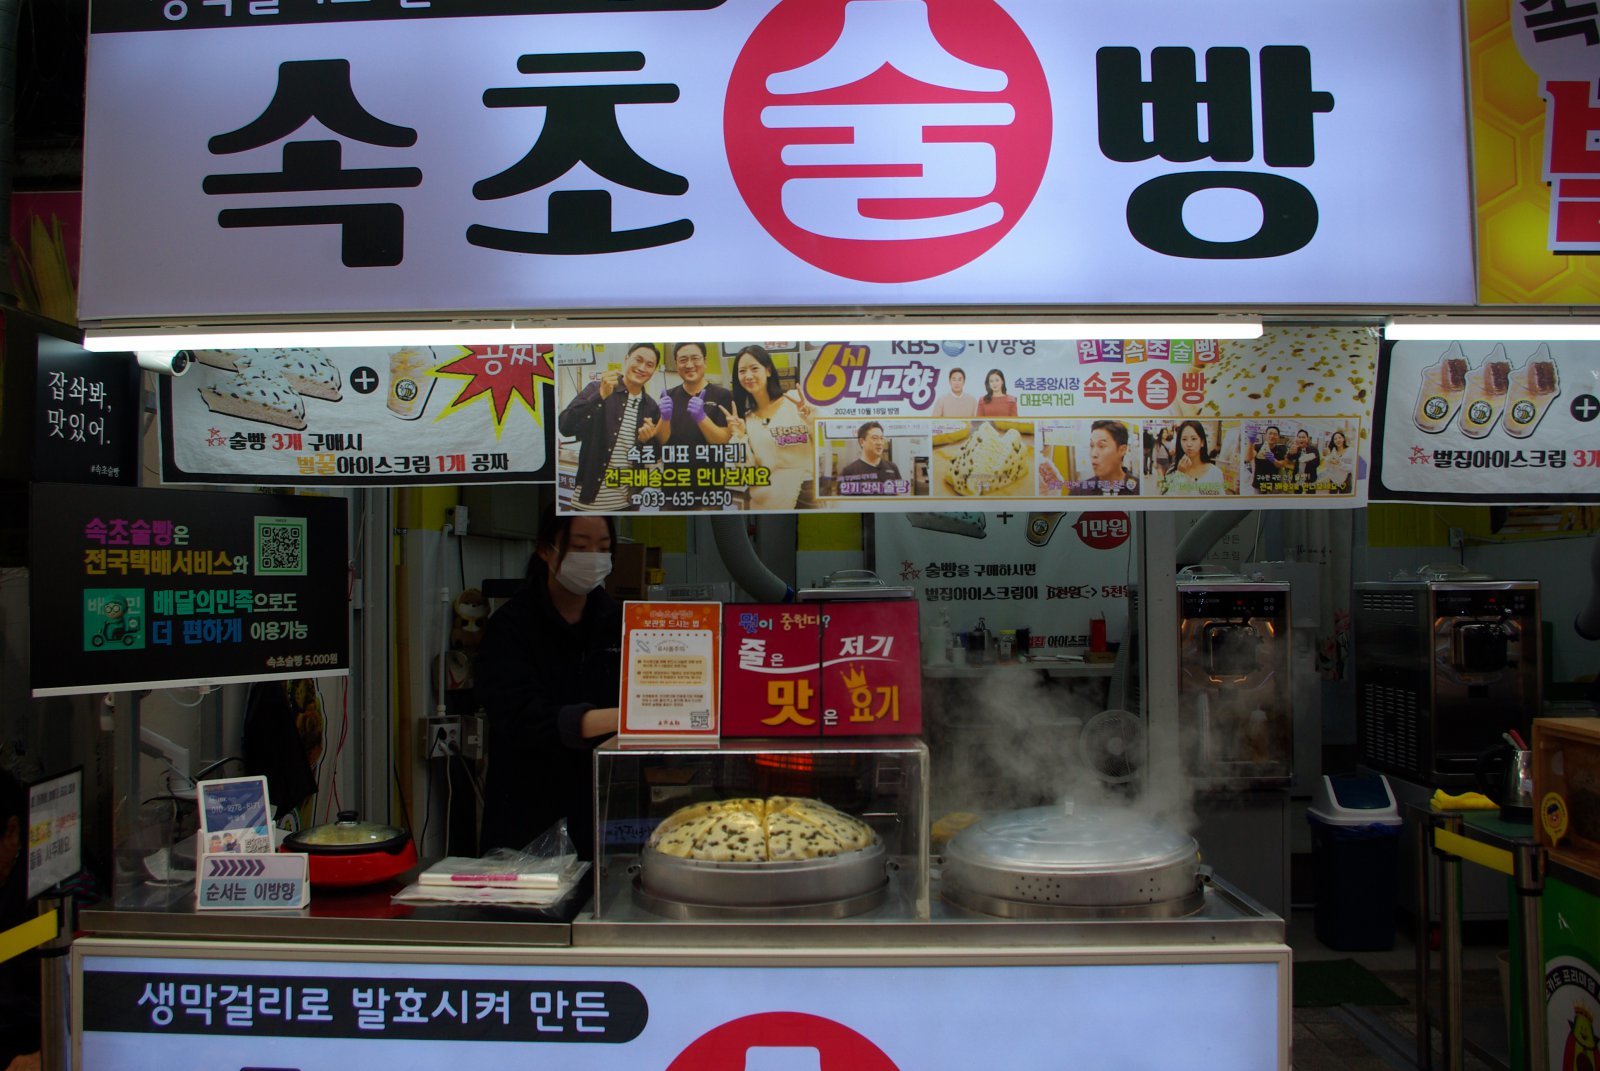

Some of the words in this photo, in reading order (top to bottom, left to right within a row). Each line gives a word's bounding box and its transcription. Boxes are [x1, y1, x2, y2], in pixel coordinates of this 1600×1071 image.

[202, 0, 1334, 268] 속초술빵
[805, 342, 867, 404] 6시
[849, 364, 936, 407] 내고향
[1014, 377, 1080, 391] 속초중앙시장
[1083, 370, 1207, 406] 속초술빵
[1019, 393, 1075, 407] 대표먹거리
[834, 407, 857, 416] 2024년
[857, 407, 872, 416] 10월
[47, 408, 111, 446] 맛있어.
[228, 432, 267, 451] 술빵
[271, 432, 303, 452] 3개
[307, 433, 363, 452] 구매시
[296, 453, 431, 475] 벌꿀아이스크림
[437, 453, 466, 472] 1개
[471, 453, 509, 472] 공짜
[627, 446, 656, 464] 속초
[662, 445, 690, 464] 대표
[695, 444, 746, 463] 먹거리!
[1432, 449, 1567, 469] 벌집아이스크림
[605, 468, 692, 488] 전국배송으로
[697, 467, 771, 487] 만나보세요
[642, 491, 732, 507] 033-635-6350
[84, 517, 190, 546] 속초술빵은
[1079, 518, 1128, 538] 1만원
[84, 550, 249, 576] 전국택배서비스와
[925, 562, 970, 579] 술빵을
[974, 562, 1037, 577] 구매하시면
[153, 588, 298, 616] 배달의민족으로도
[924, 585, 1039, 602] 벌집아이스크림이
[152, 619, 173, 646] 더
[183, 618, 243, 644] 편하게
[251, 620, 309, 642] 이용가능
[780, 612, 831, 634] 중헌디?
[738, 637, 784, 668] 줄은
[839, 635, 894, 657] 저기
[1047, 635, 1092, 649] 아이스크
[305, 653, 338, 669] 5,000원
[760, 679, 839, 727] 맛은
[849, 684, 900, 723] 요기
[206, 882, 247, 901] 순서는
[254, 881, 296, 901] 이방향
[137, 982, 333, 1028] 생막걸리로
[352, 986, 511, 1030] 발효시켜
[530, 990, 610, 1034] 만든
